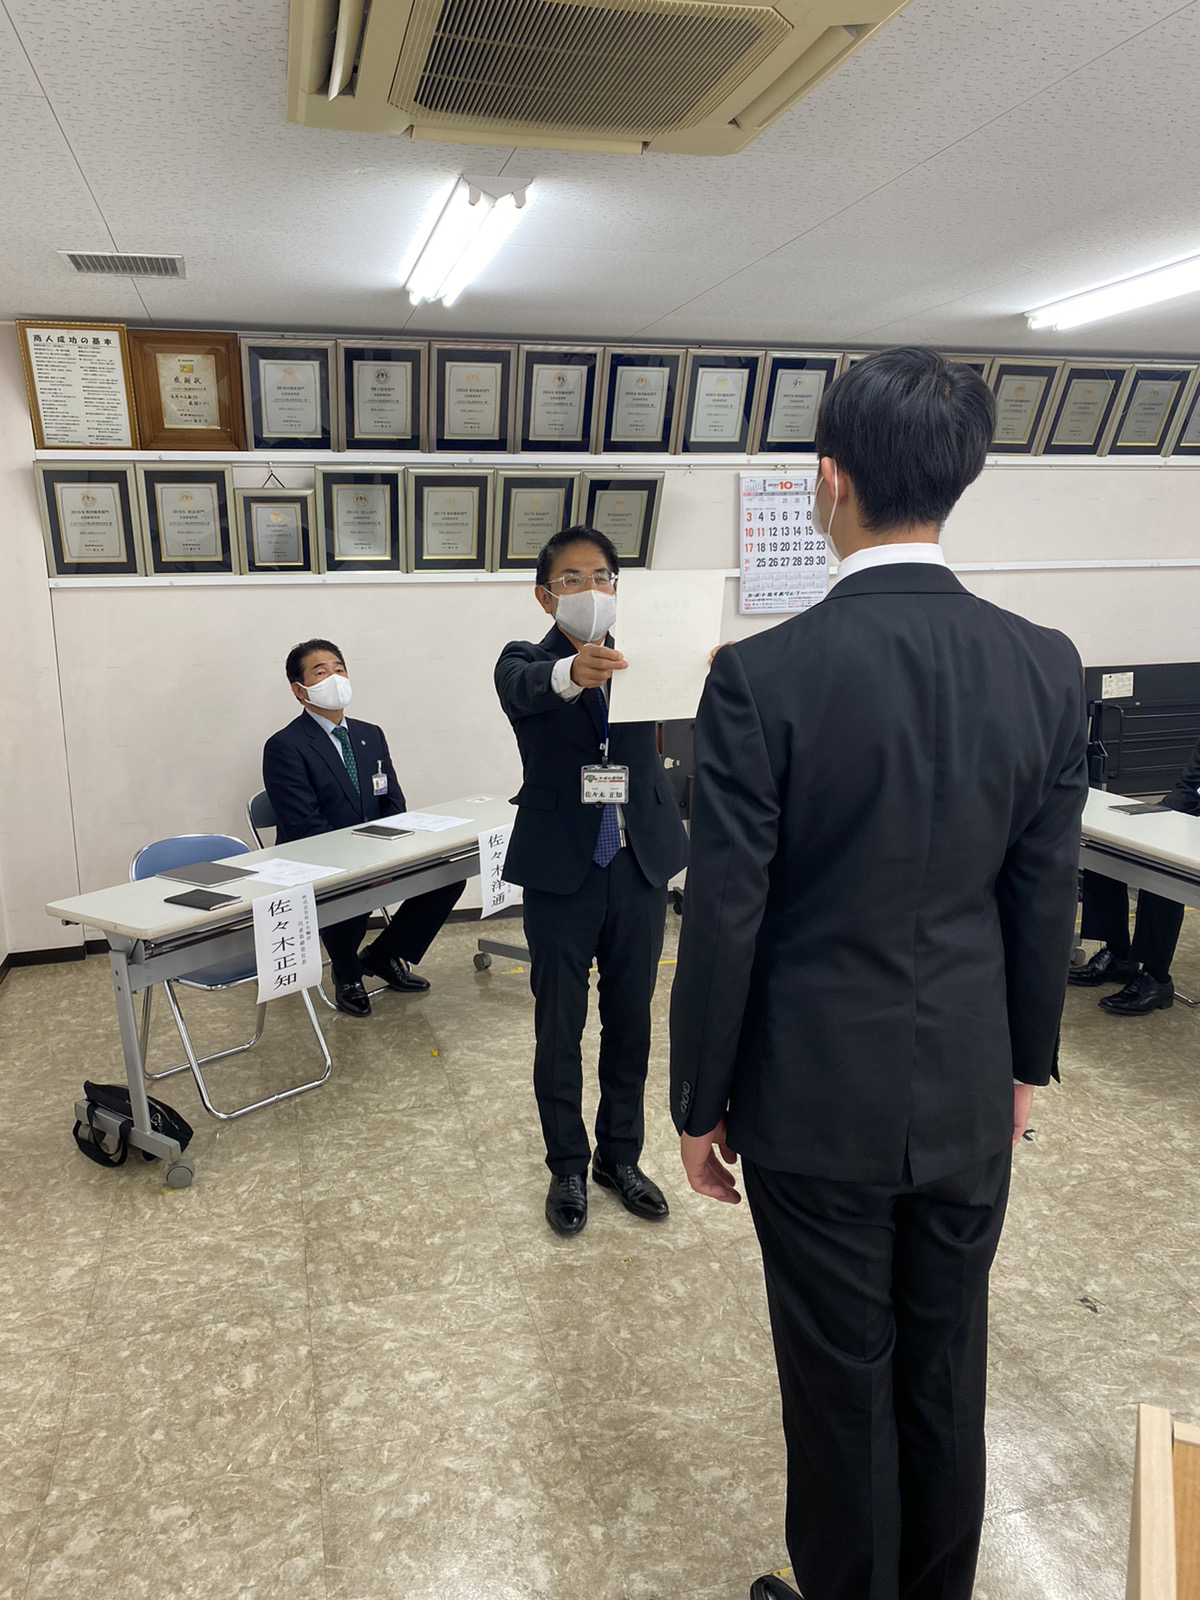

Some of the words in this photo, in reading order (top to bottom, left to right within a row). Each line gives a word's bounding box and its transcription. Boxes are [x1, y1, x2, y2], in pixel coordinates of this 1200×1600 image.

[33, 334, 112, 346] 商人成功の基本
[174, 376, 202, 384] 感謝状
[779, 481, 793, 490] 10
[807, 496, 811, 505] 1
[747, 512, 752, 521] 3
[759, 512, 764, 521] 4
[771, 512, 775, 521] 5
[783, 512, 787, 521] 6
[795, 512, 799, 520] 7
[807, 511, 811, 520] 8
[745, 528, 753, 537] 10
[757, 528, 764, 536] 11
[769, 527, 777, 536] 12
[781, 527, 789, 536] 13
[793, 527, 801, 535] 14
[805, 526, 813, 535] 15
[745, 543, 753, 552] 17
[757, 543, 765, 552] 18
[769, 543, 777, 552] 19
[781, 542, 790, 551] 20
[793, 542, 801, 550] 21
[804, 541, 814, 550] 22
[816, 541, 826, 550] 23
[757, 559, 766, 567] 25
[769, 558, 778, 567] 26
[781, 558, 789, 567] 27
[793, 557, 802, 566] 28
[805, 557, 814, 566] 29
[816, 556, 826, 565] 30
[488, 834, 506, 907] 佐々木洋通
[268, 899, 297, 991] 佐々木正知
